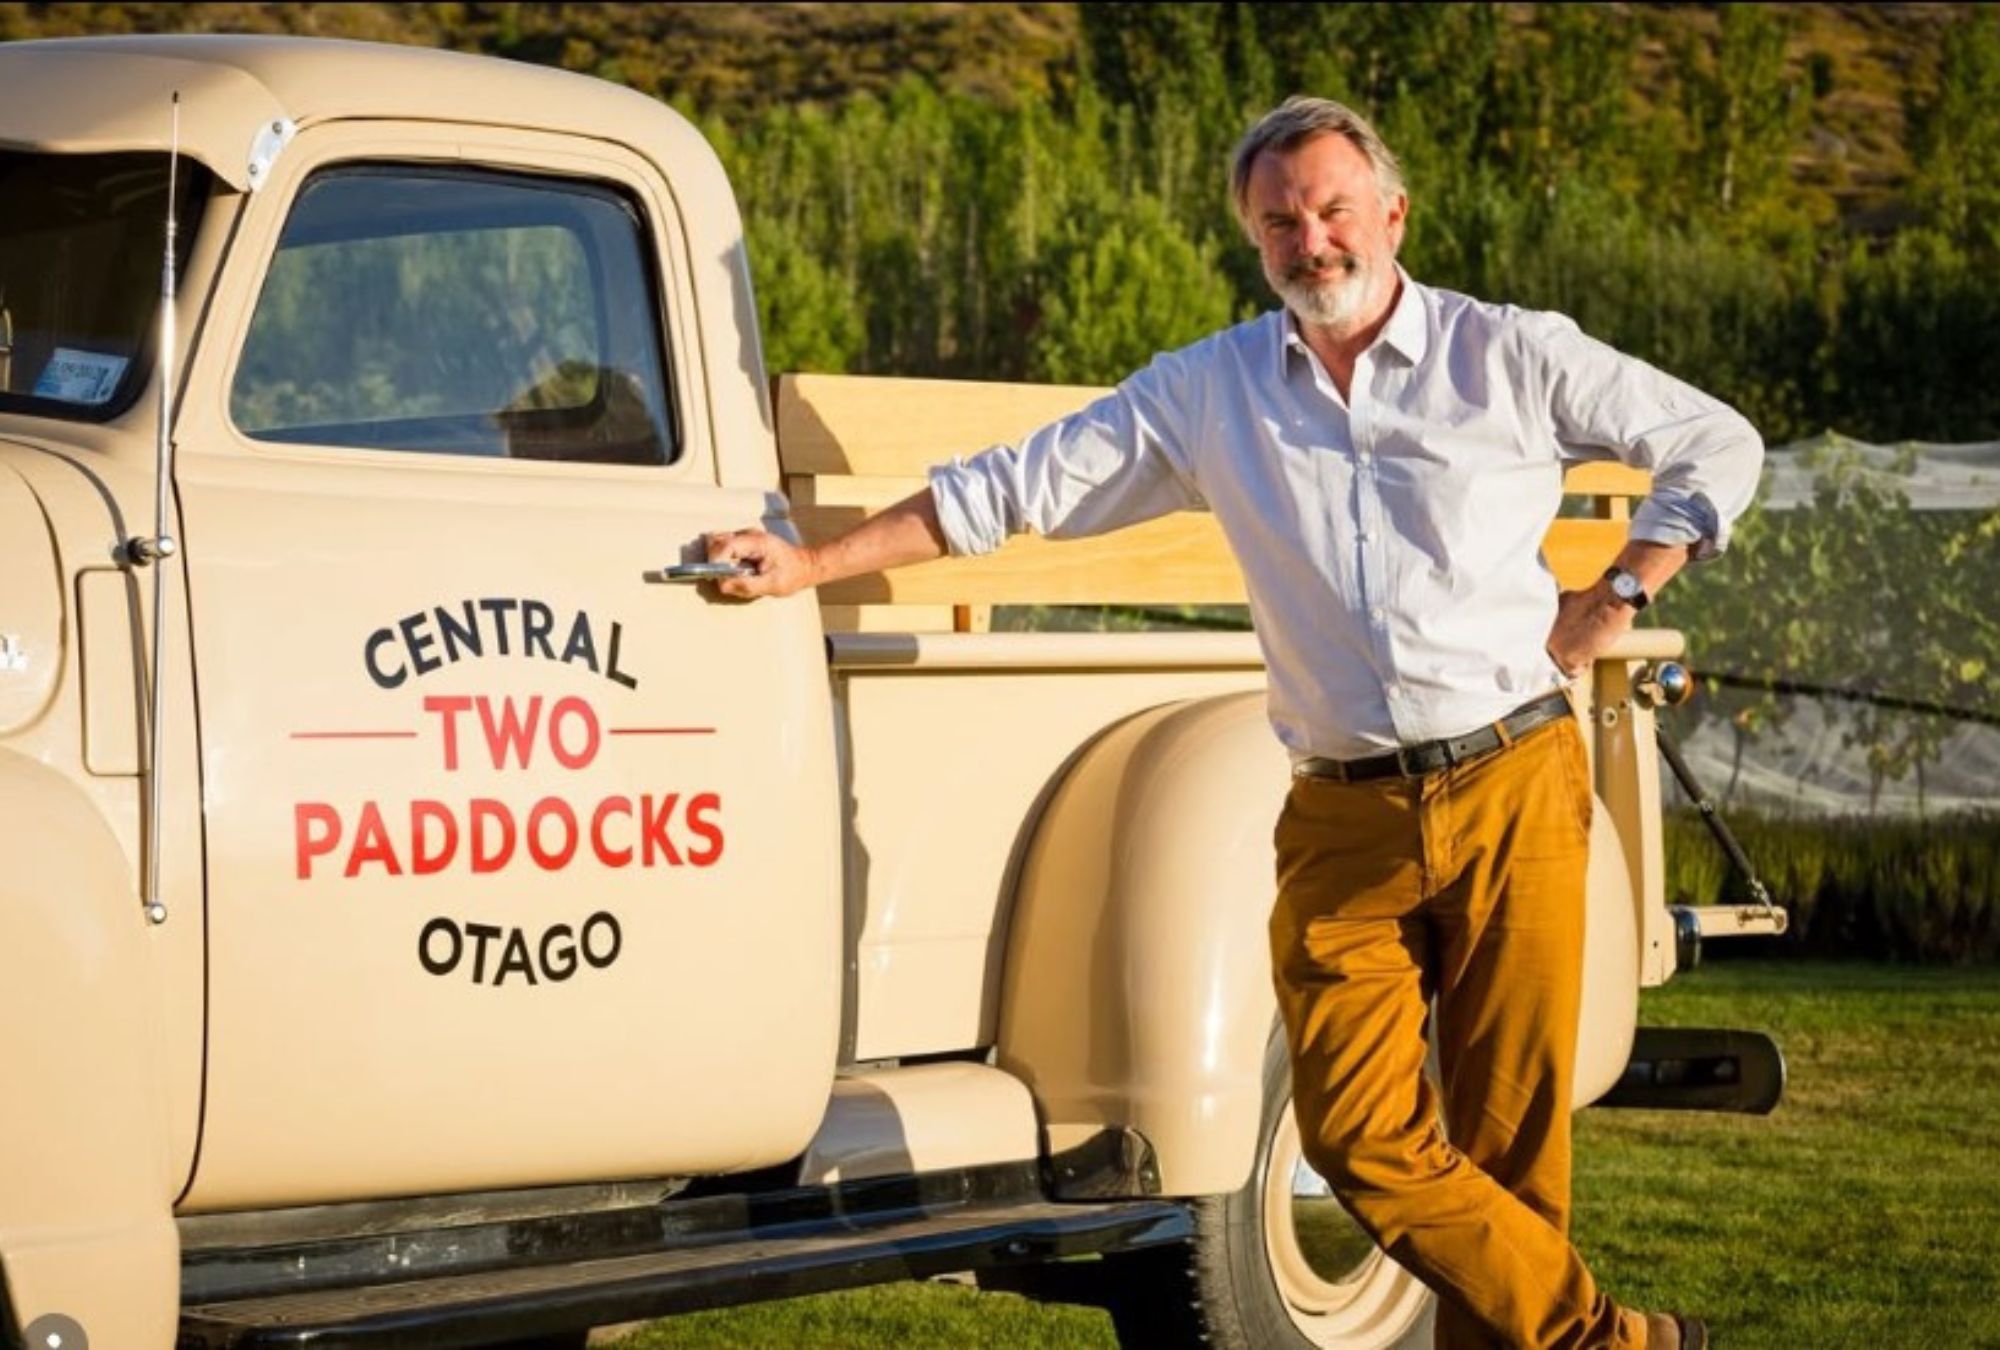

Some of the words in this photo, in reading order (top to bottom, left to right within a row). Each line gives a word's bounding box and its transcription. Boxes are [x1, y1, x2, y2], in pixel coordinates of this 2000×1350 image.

[364, 597, 638, 690] CENTRAL
[424, 695, 600, 771] TWO
[295, 792, 725, 880] PADDOCKS
[418, 910, 622, 987] OTAGO
